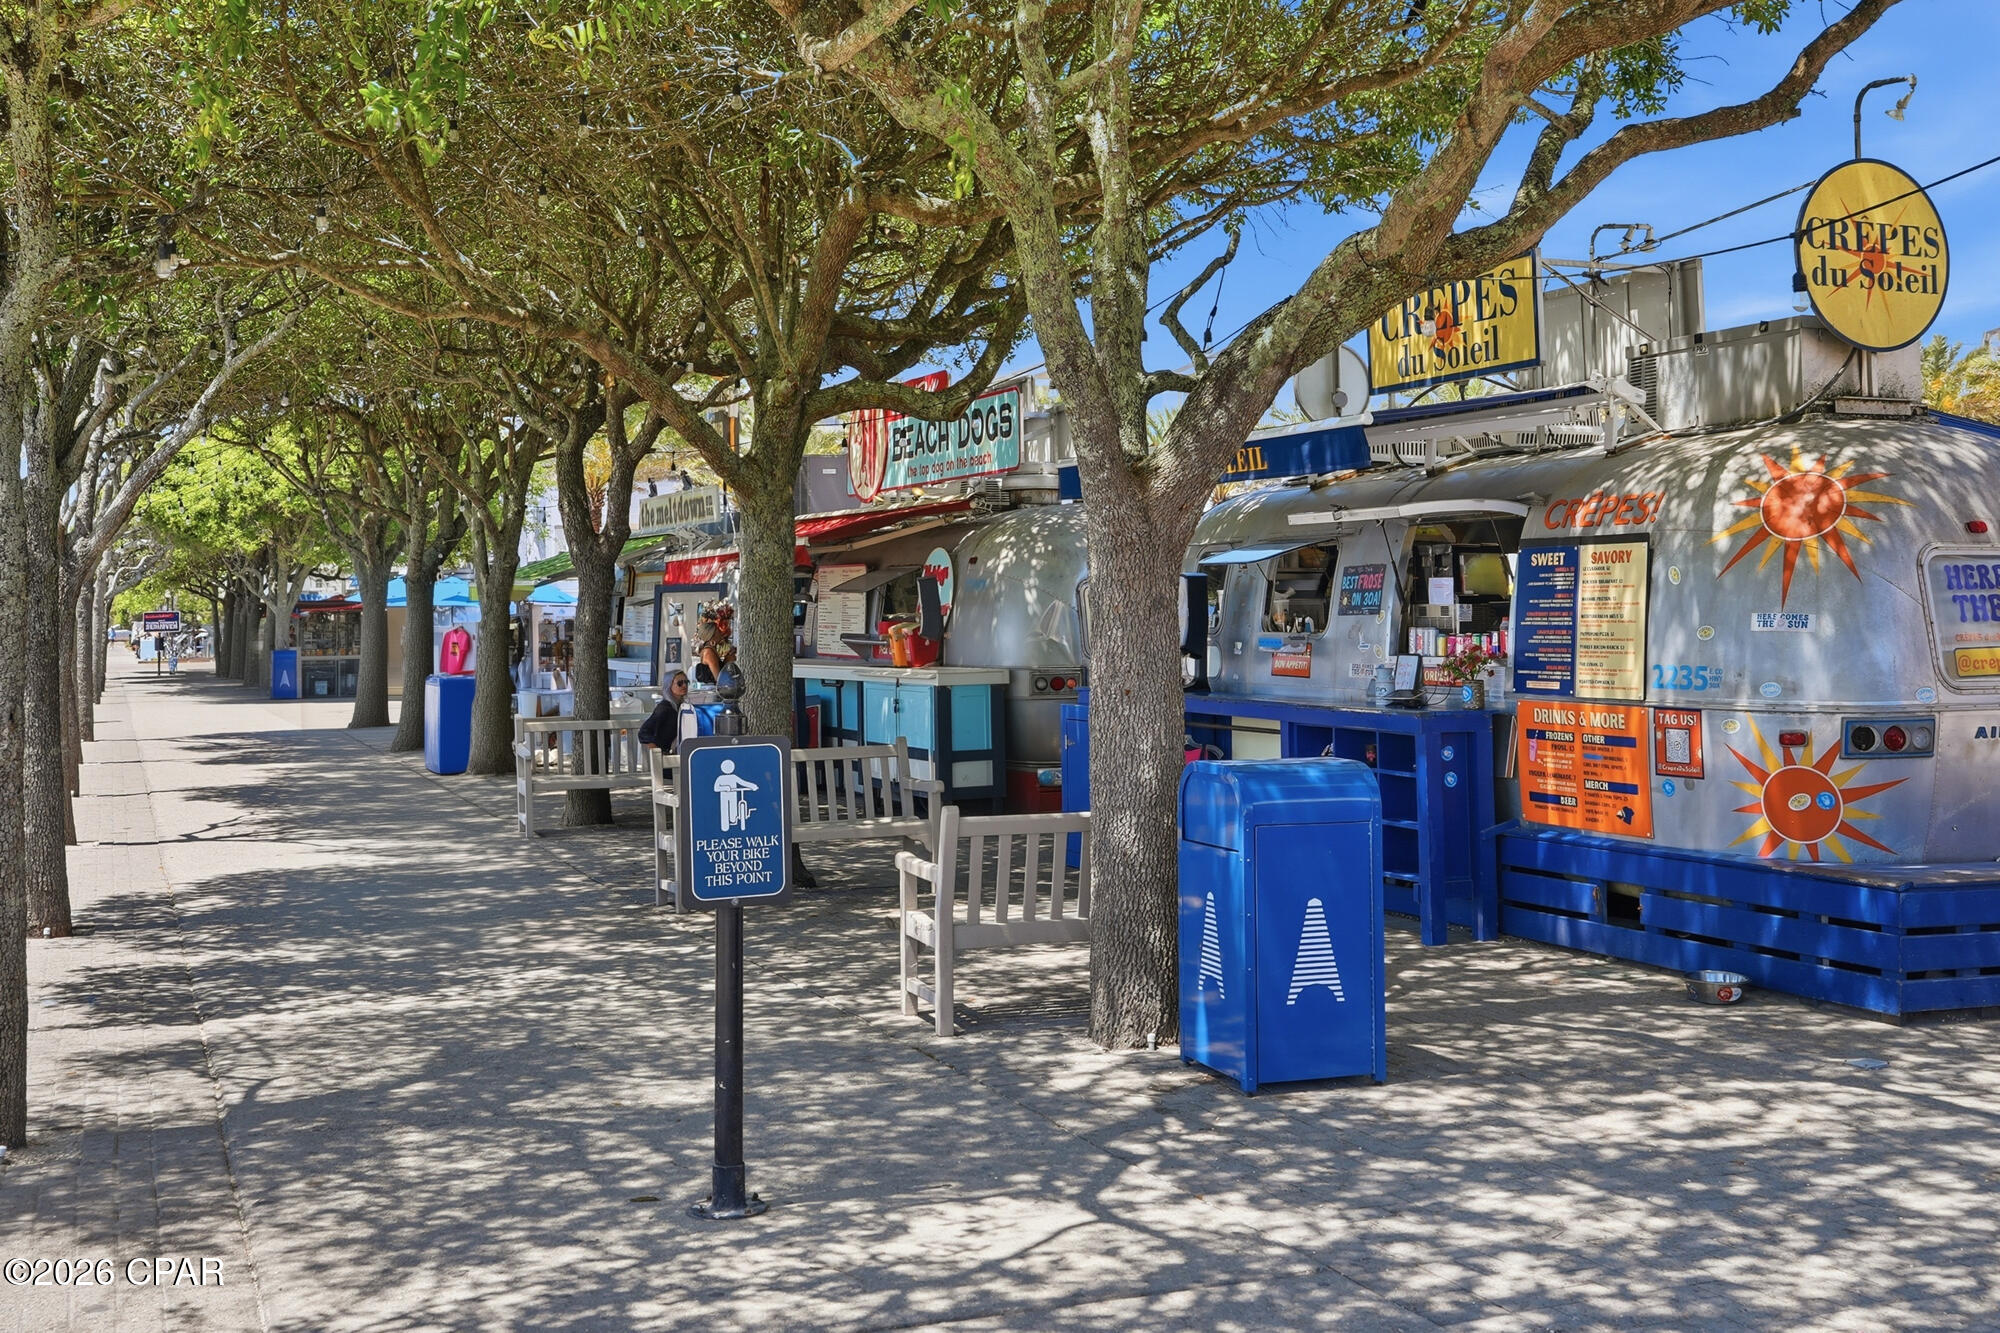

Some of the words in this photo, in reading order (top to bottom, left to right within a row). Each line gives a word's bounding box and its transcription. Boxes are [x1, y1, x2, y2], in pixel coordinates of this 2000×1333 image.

[1806, 216, 1940, 260] CRÊPES
[1812, 255, 1849, 288] du
[1859, 258, 1940, 295] Soleil
[1397, 344, 1426, 378] du
[1433, 325, 1500, 372] Soleil
[892, 420, 950, 463] BEACH
[958, 402, 1012, 449] DOGS
[1227, 446, 1268, 474] LEIL
[641, 502, 655, 528] the
[1543, 490, 1666, 530] CRÊPES!
[1530, 552, 1566, 567] SWEET
[1591, 549, 1633, 565] SAVORY
[1341, 575, 1359, 590] BEST
[1357, 567, 1384, 590] FROSÉ
[1351, 592, 1362, 606] ON
[1756, 620, 1775, 628] THE
[1787, 620, 1808, 629] SUN
[1780, 613, 1809, 621] COMES
[1957, 654, 2000, 674] @cre
[1652, 664, 1709, 692] 2235
[1533, 707, 1576, 726] DRINKS
[1579, 711, 1587, 727] &
[1590, 711, 1626, 729] MORE
[1658, 713, 1678, 725] TAG
[1679, 714, 1697, 726] US!
[1545, 731, 1574, 742] FROZENS
[1582, 734, 1606, 745] OTHER
[1584, 779, 1609, 791] MERCH
[1560, 796, 1577, 806] BEER
[696, 837, 743, 852] PLEASE
[745, 835, 779, 848] WALK
[706, 850, 740, 863] YOUR
[742, 847, 770, 860] BIKE
[714, 860, 763, 874] BEYOND
[705, 874, 733, 887] THIS
[736, 871, 773, 885] POINT
